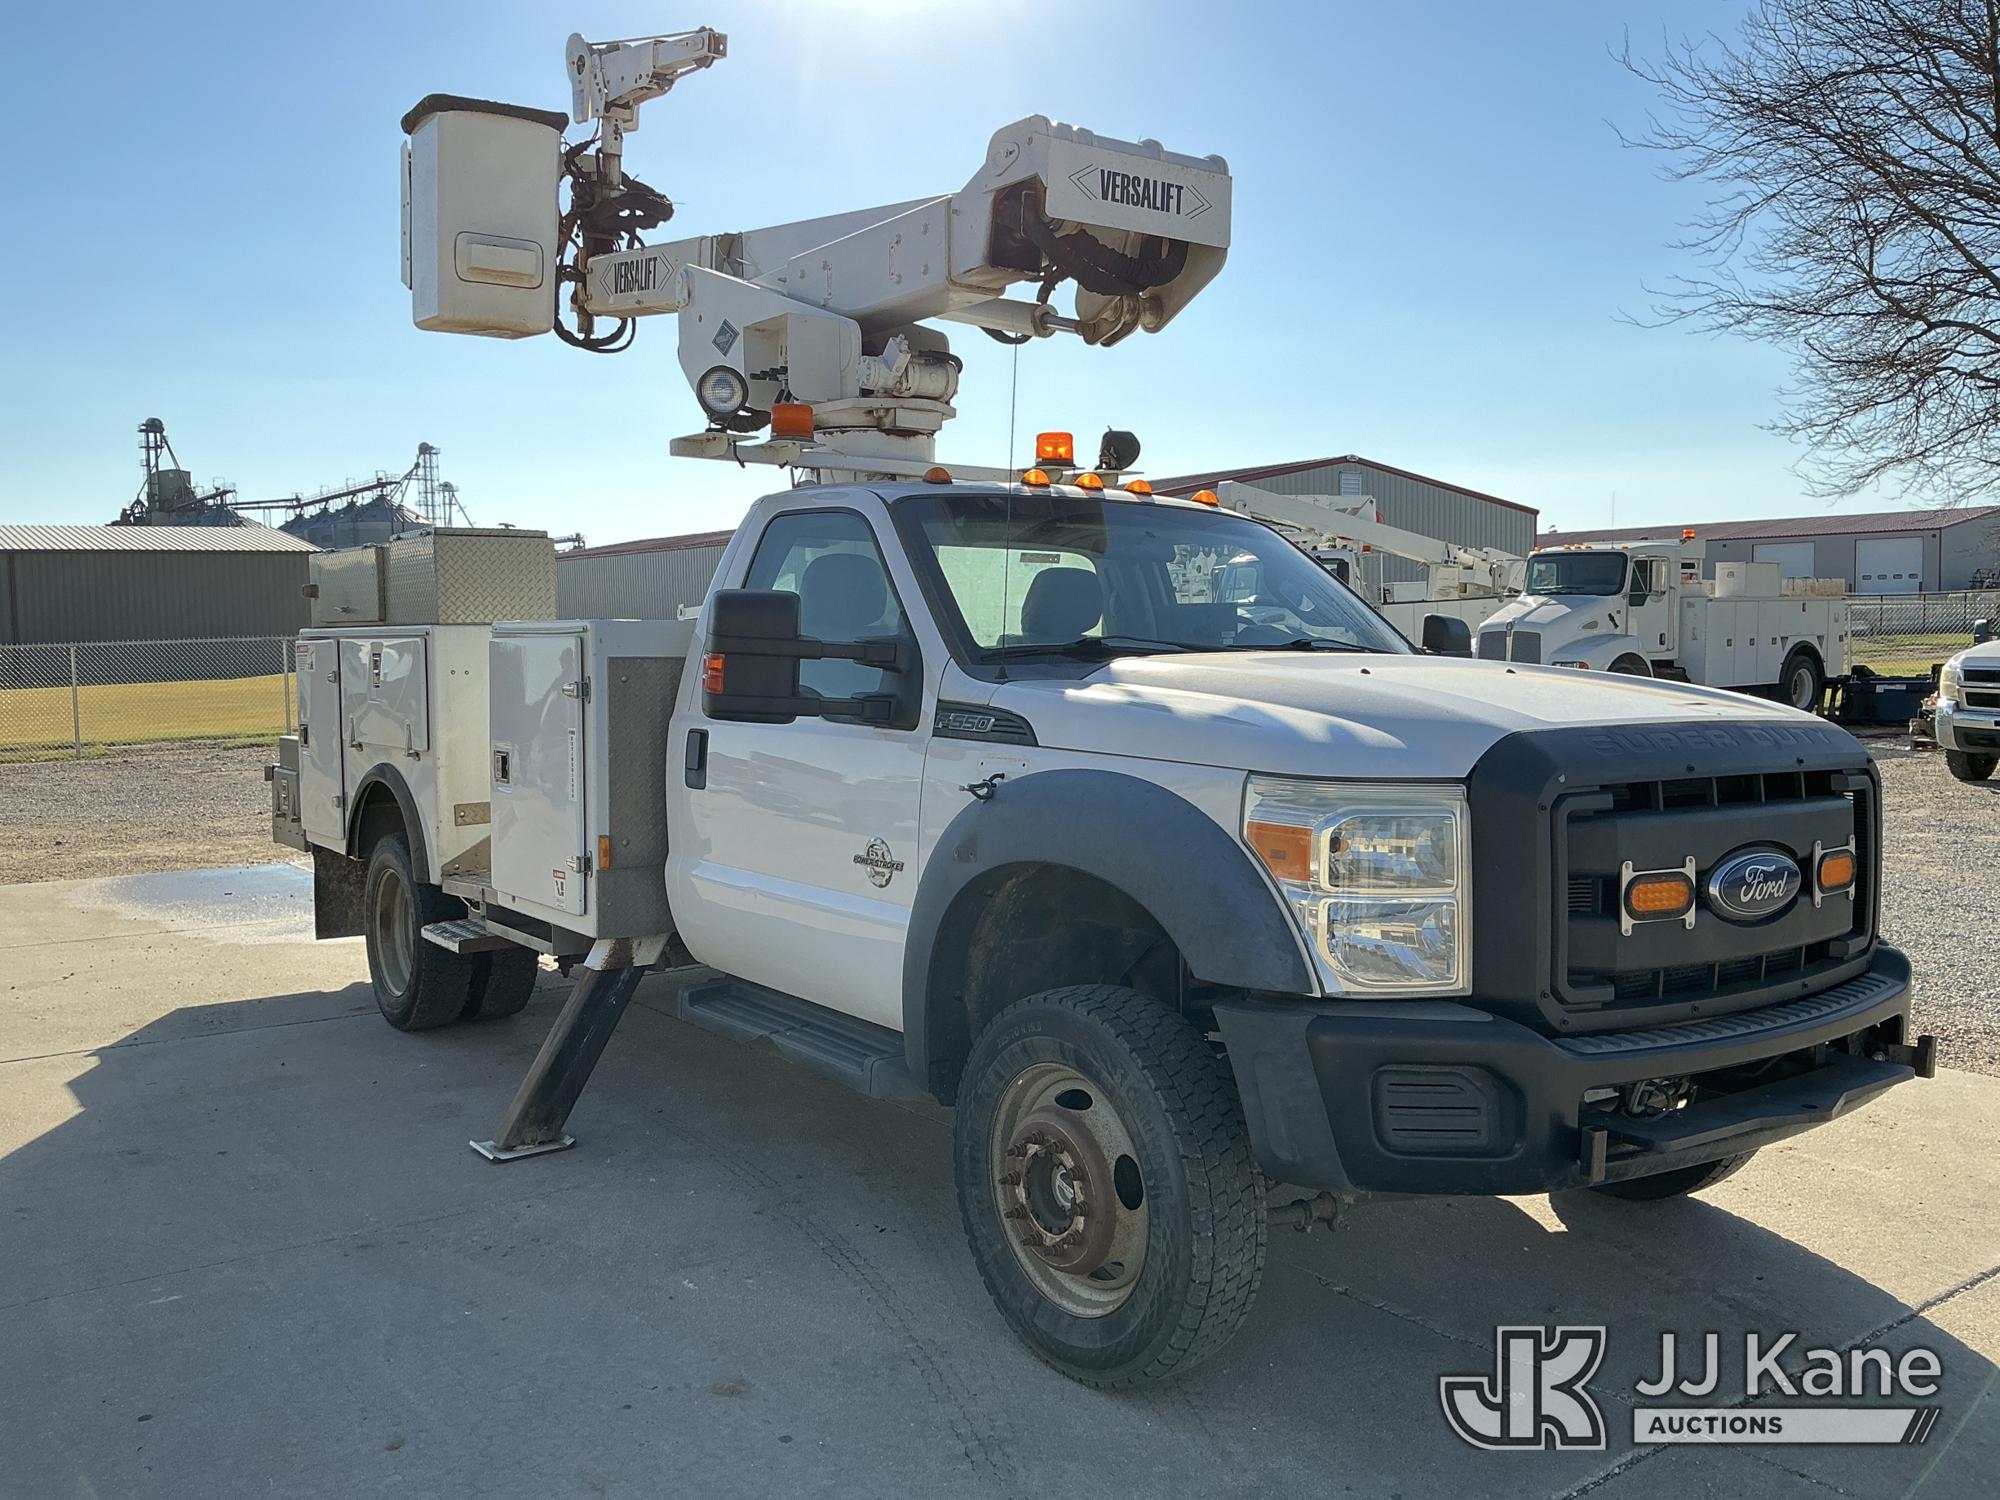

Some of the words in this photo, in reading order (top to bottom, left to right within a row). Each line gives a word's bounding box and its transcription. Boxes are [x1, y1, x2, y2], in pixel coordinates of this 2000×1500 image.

[1100, 169, 1184, 215] VERSALIFT
[614, 257, 658, 294] VERSALIFT
[936, 712, 995, 733] F-550
[1584, 727, 1742, 757] SUPER
[1748, 727, 1832, 746] DUTY
[1740, 864, 1788, 902] Ford
